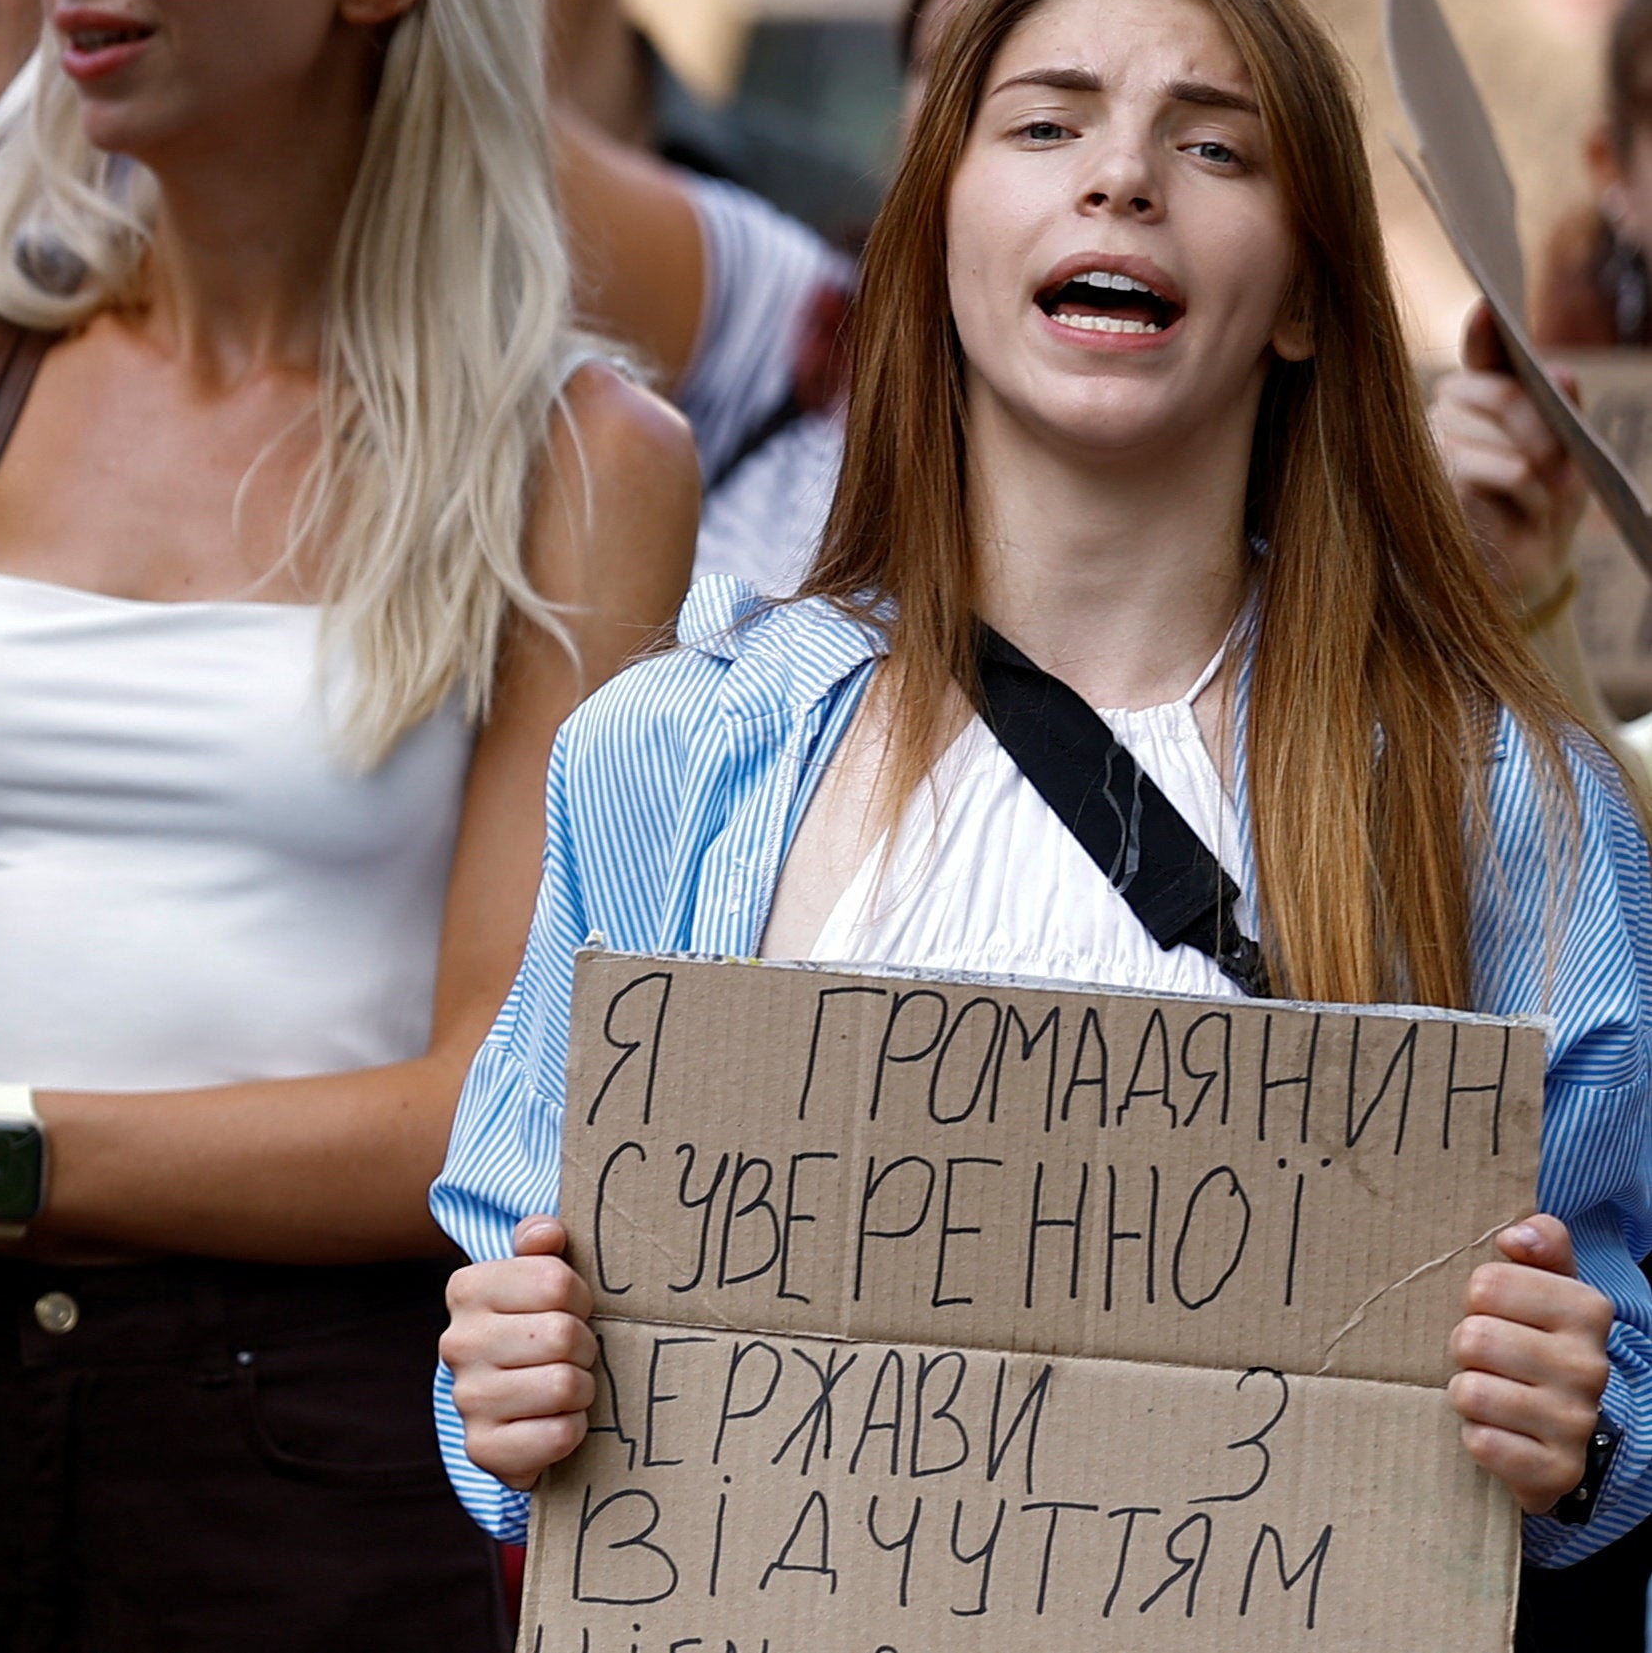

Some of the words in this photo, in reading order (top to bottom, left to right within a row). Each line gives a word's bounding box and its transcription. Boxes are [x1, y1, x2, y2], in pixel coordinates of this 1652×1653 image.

[586, 970, 674, 1127] Я
[797, 985, 1514, 1157] ГРОМАДЯНИН
[592, 1140, 1336, 1314] СУВЕРЕННОЇ
[571, 1474, 1336, 1631] ВІДЧУТТЯМ
